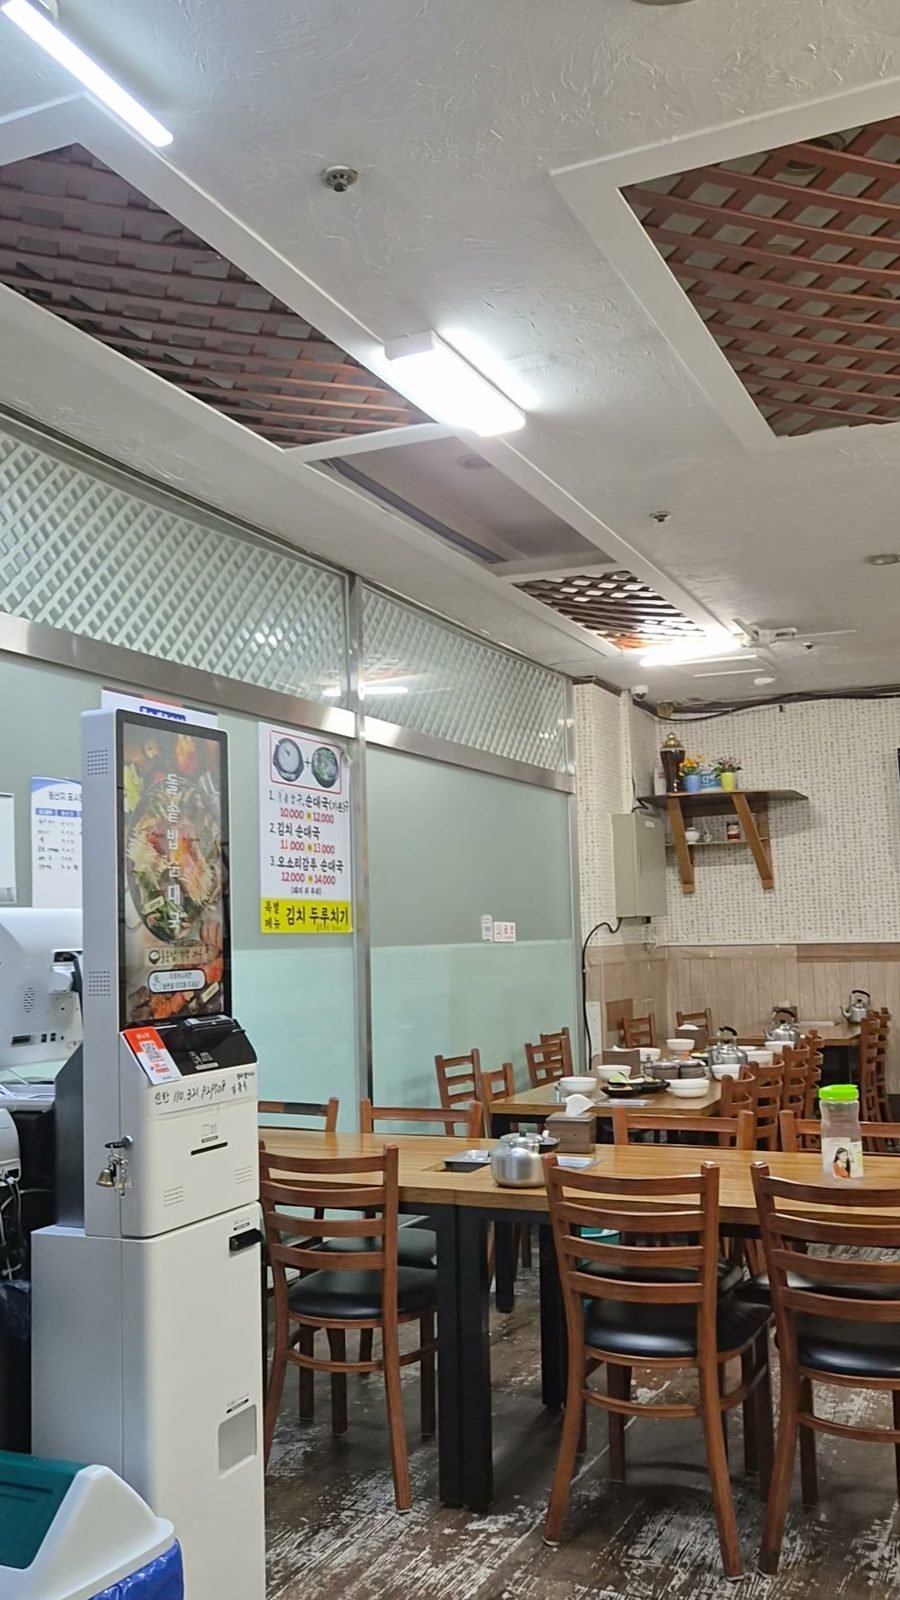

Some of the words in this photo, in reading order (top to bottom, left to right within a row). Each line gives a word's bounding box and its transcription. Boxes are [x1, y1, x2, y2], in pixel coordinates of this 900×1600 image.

[295, 823, 320, 840] 순대국
[320, 858, 344, 874] 순대국
[286, 905, 305, 926] 김치
[309, 906, 349, 926] 두루치기
